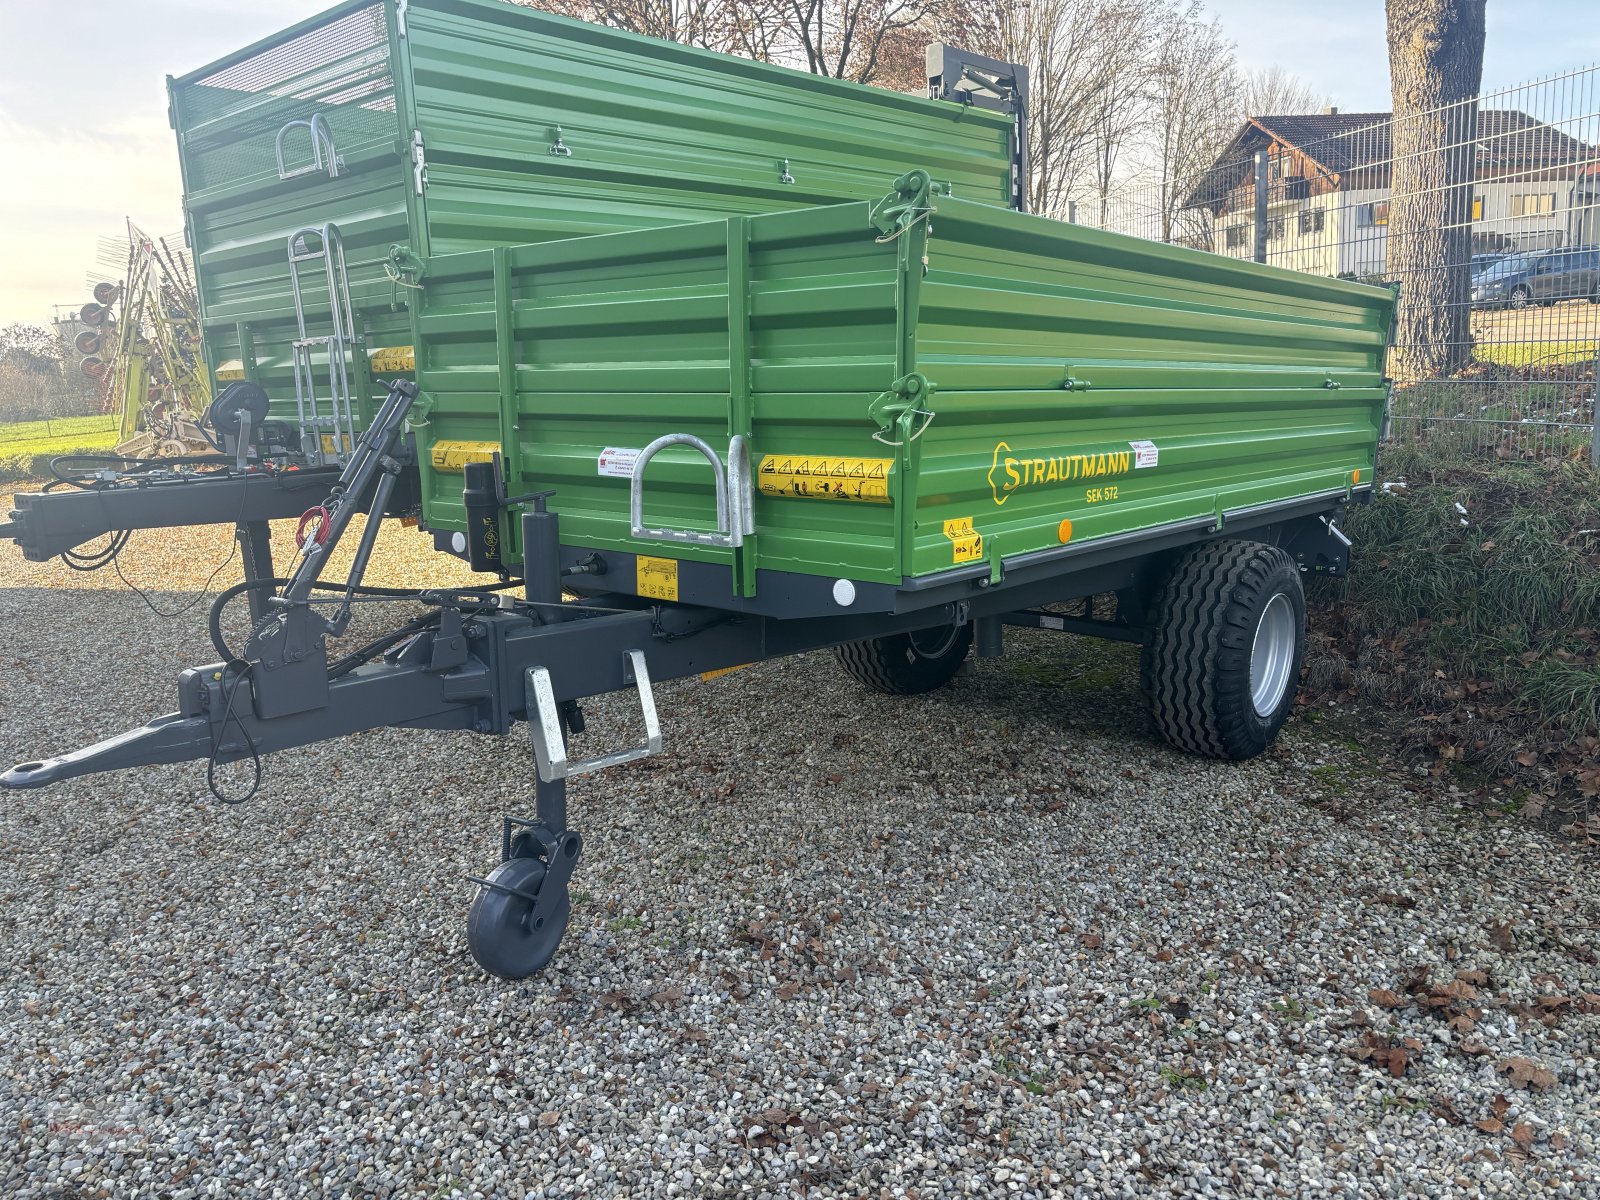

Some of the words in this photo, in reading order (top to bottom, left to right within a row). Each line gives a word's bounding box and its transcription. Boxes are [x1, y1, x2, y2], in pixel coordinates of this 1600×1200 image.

[1003, 451, 1129, 490] STRAUTMANN
[1086, 489, 1103, 503] SEK
[1104, 486, 1118, 501] 572
